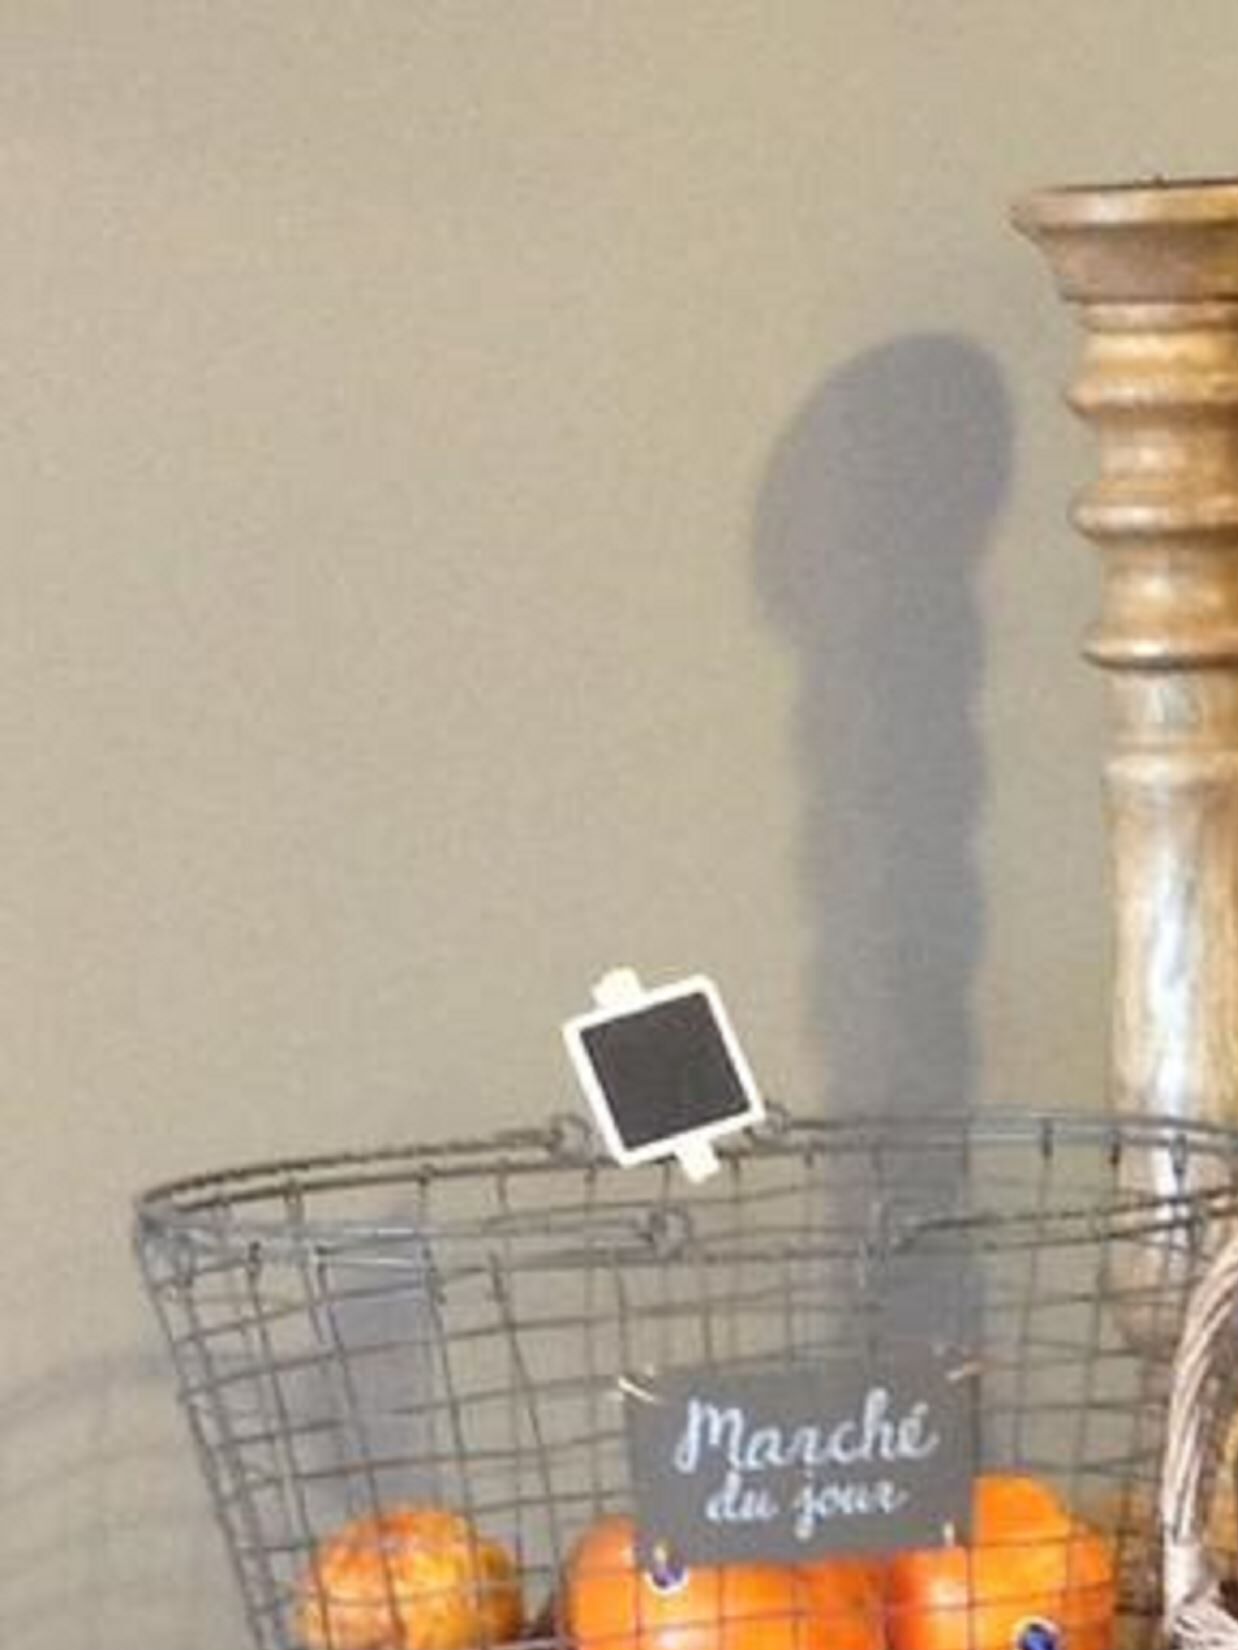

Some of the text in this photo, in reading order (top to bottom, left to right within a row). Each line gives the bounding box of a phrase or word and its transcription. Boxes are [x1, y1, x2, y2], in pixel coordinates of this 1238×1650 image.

[674, 1387, 940, 1473] Marché
[705, 1468, 909, 1539] du jour
